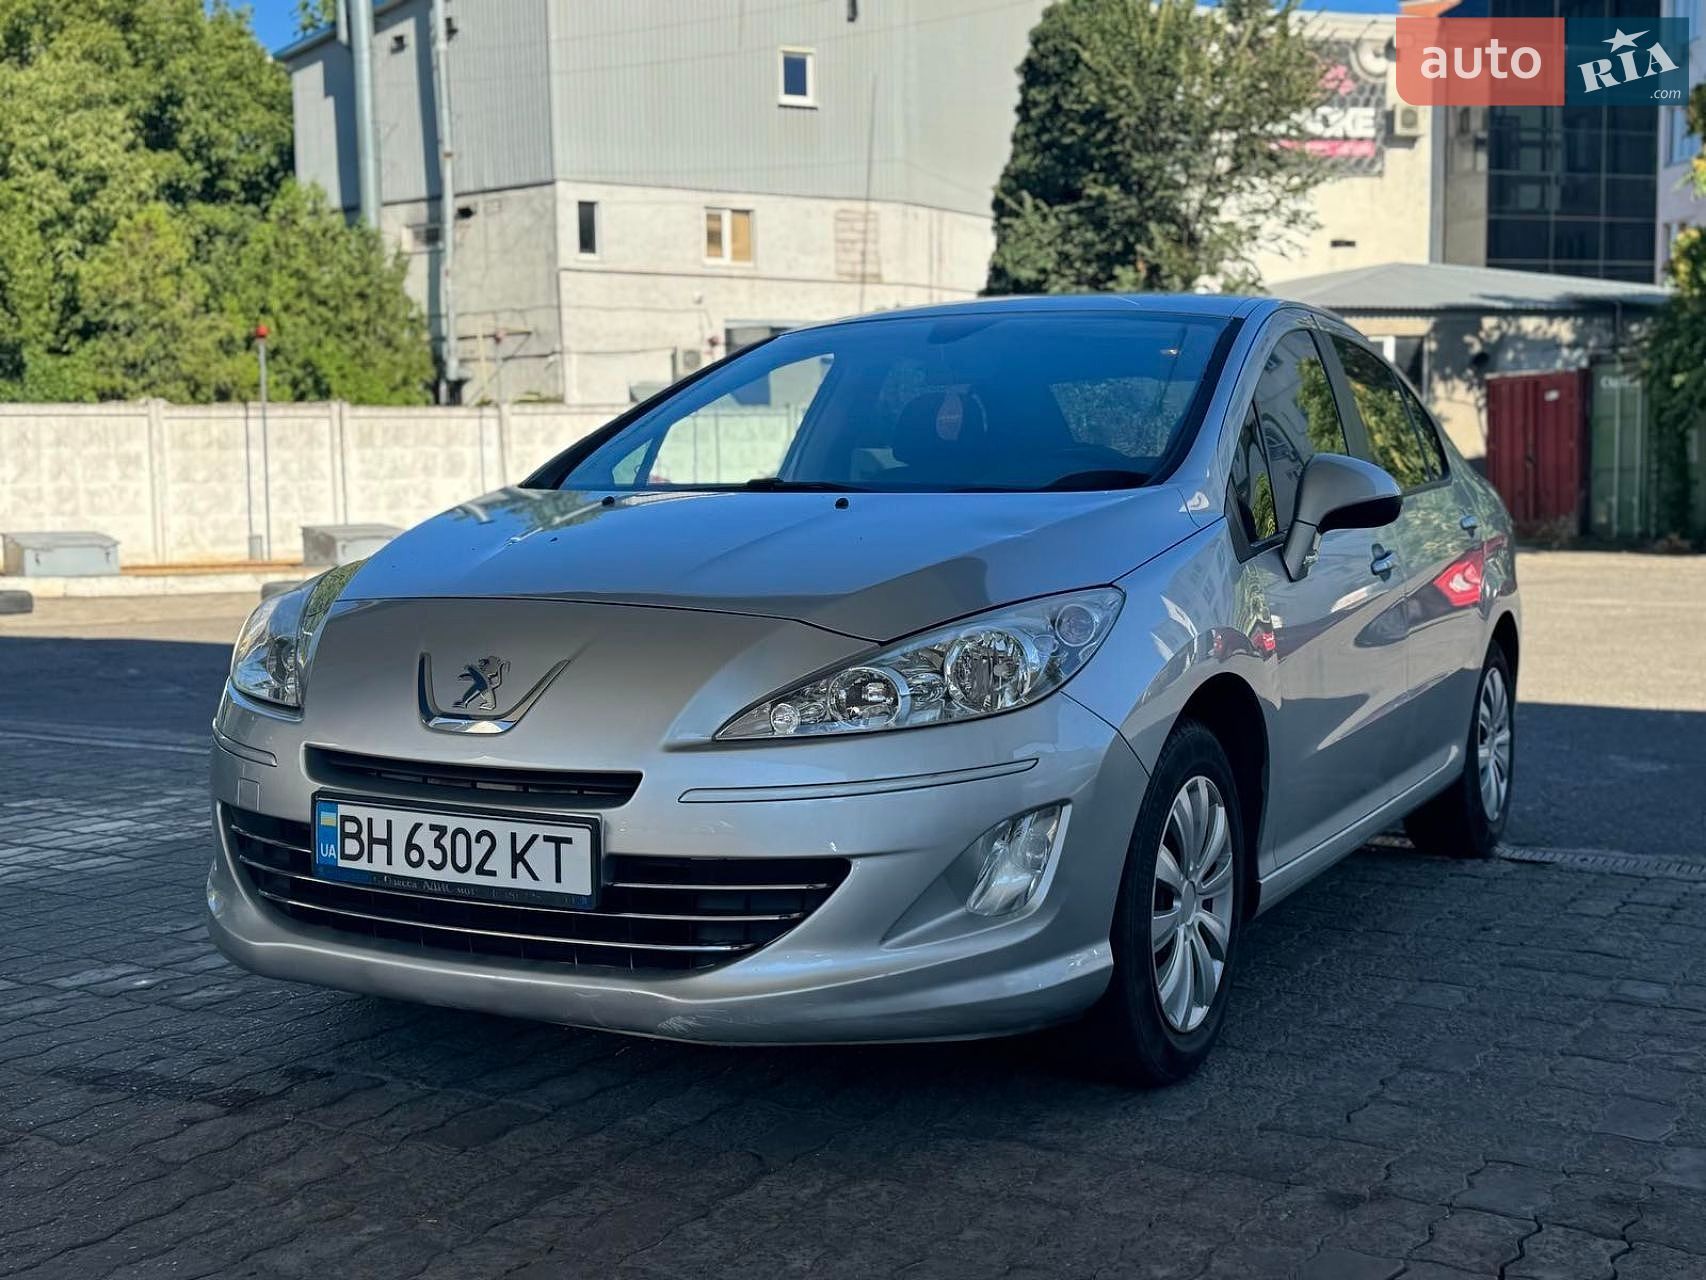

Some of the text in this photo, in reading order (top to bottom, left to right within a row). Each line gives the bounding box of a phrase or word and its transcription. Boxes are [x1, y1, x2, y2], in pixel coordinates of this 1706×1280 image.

[320, 843, 337, 858] UA
[339, 815, 573, 884] BH 6302 KT
